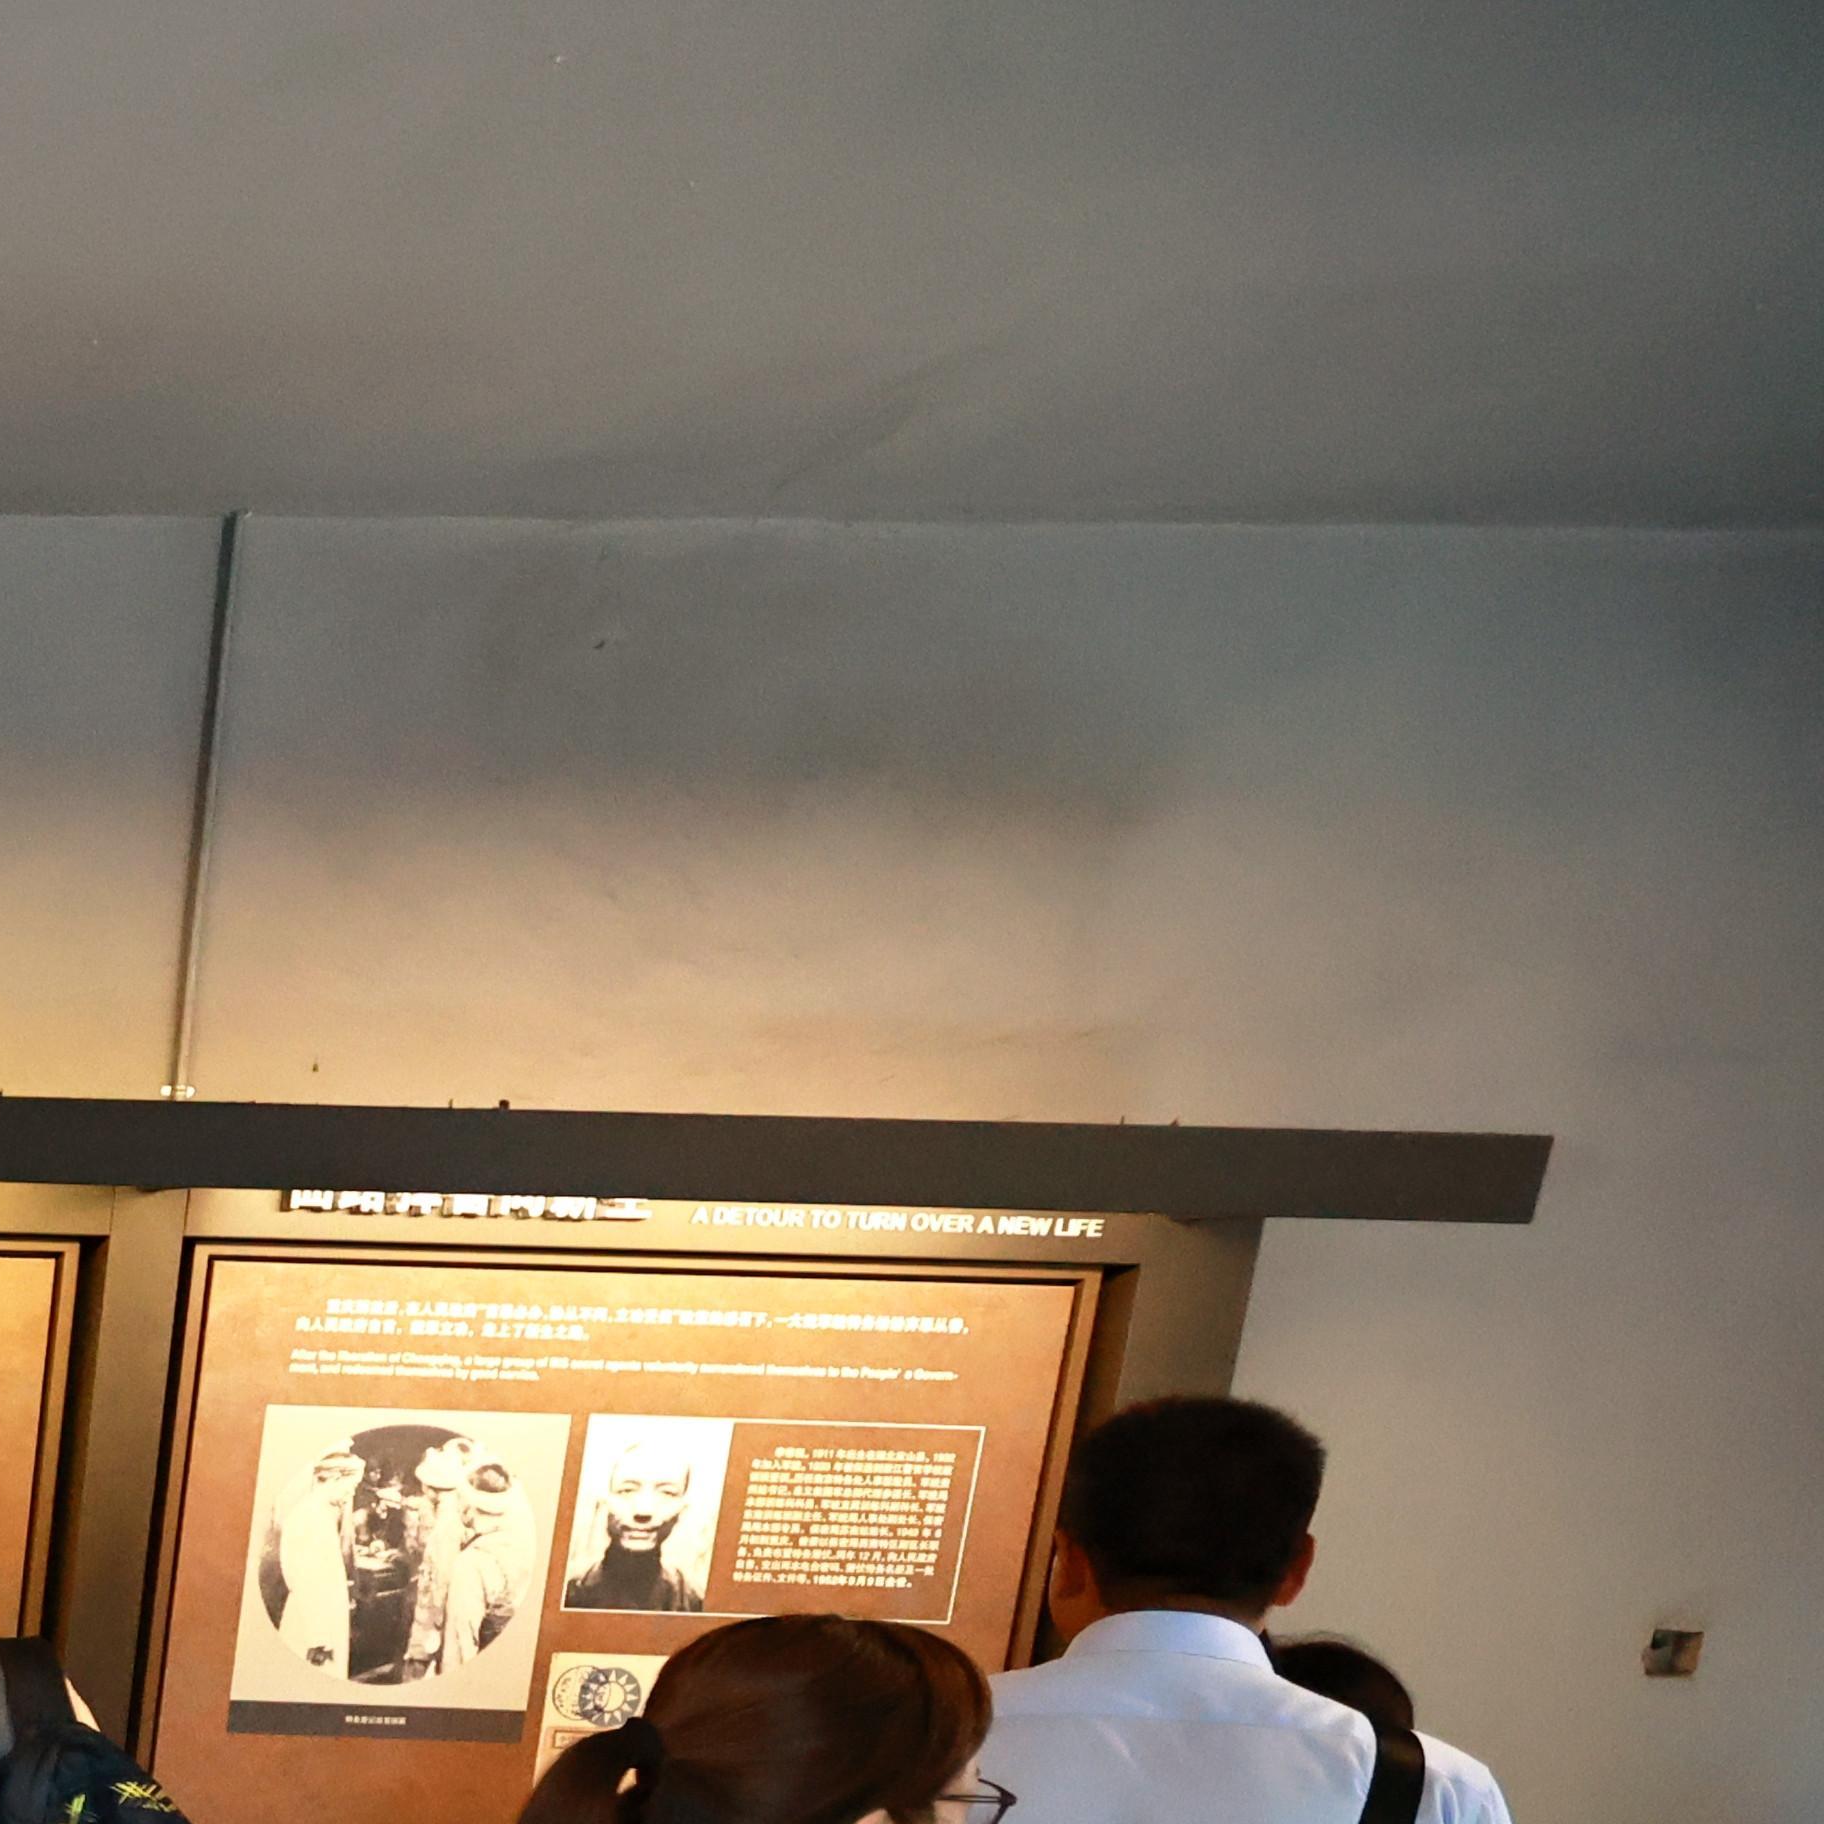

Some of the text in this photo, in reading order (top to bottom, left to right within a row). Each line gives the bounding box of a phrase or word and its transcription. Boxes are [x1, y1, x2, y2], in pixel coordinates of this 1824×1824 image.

[692, 1208, 1104, 1238] A DETOUR TO TURN OVER A NEW LIFE
